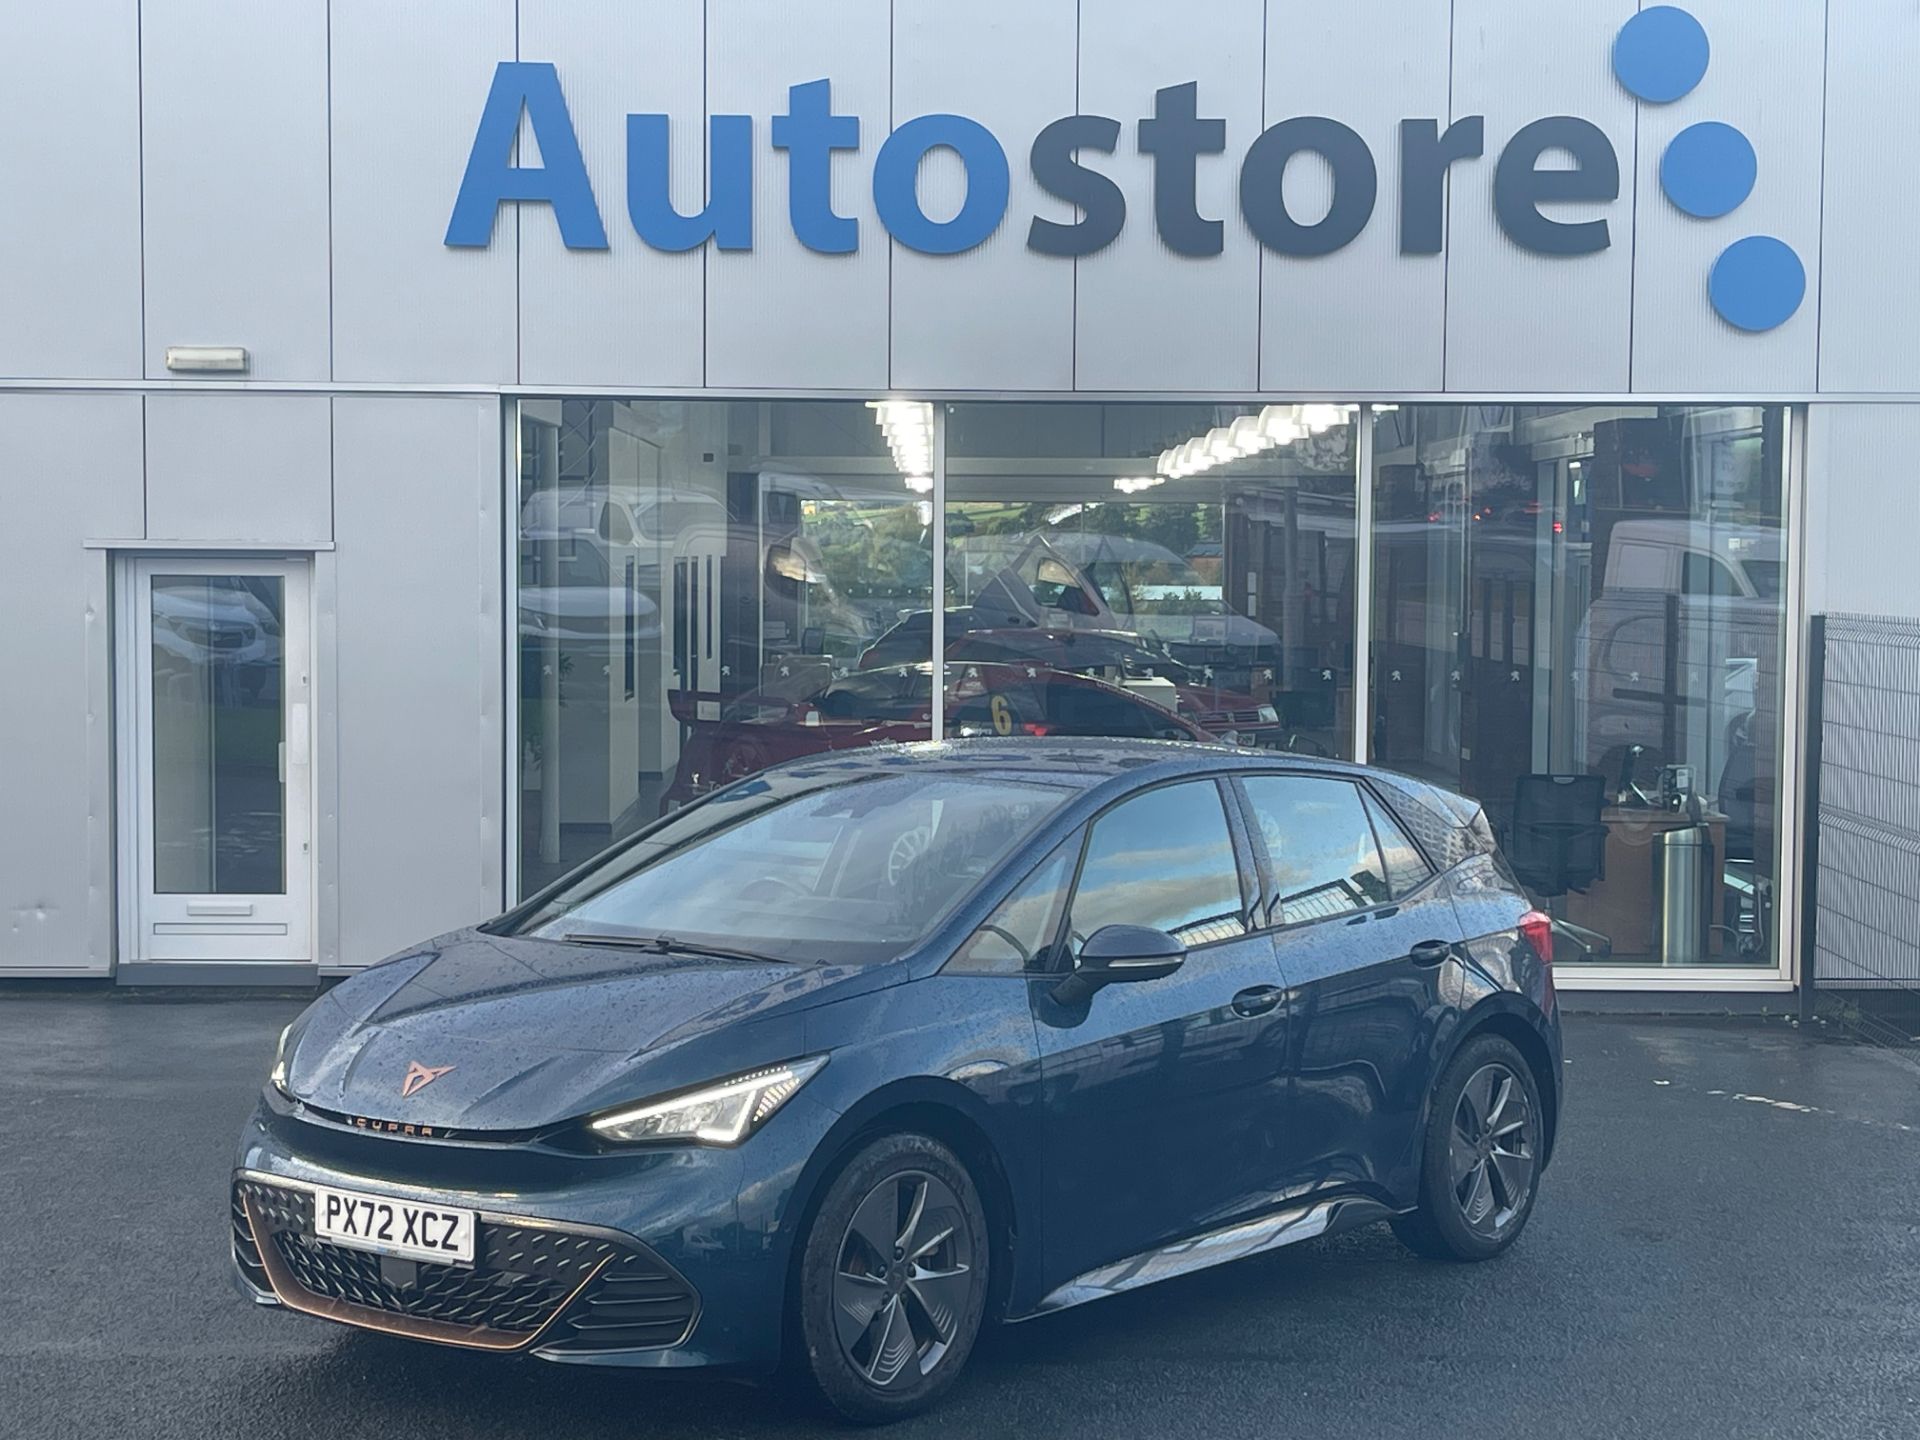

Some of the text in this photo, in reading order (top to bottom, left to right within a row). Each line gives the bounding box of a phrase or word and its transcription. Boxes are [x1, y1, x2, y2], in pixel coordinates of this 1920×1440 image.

[444, 61, 1620, 257] Autostore
[991, 695, 1012, 736] 6
[356, 1117, 433, 1137] CUPRA
[327, 1194, 459, 1252] PX72 XCZ
